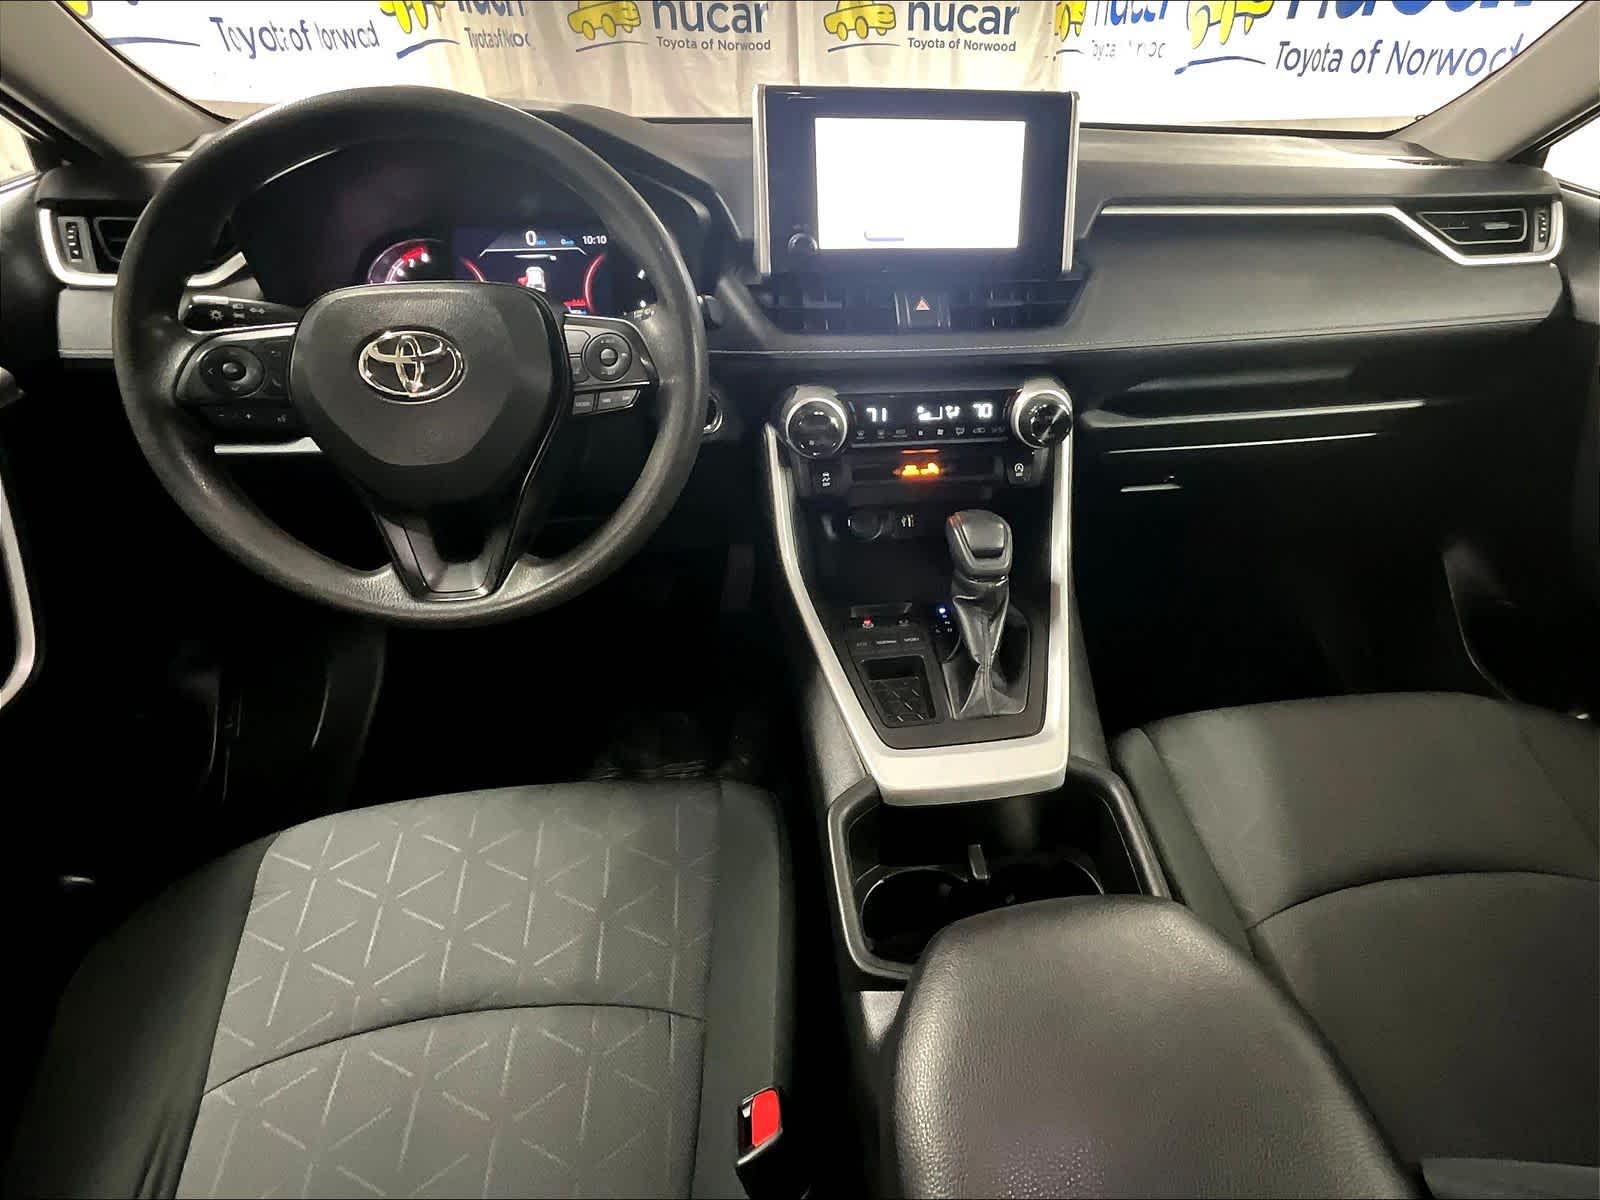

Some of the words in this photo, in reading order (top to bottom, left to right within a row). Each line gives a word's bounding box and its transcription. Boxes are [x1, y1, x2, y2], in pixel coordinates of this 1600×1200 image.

[652, 1, 768, 33] nucar
[907, 1, 1016, 35] nucar
[656, 36, 697, 50] Toyota
[700, 38, 715, 51] of
[717, 39, 771, 51] Norwood
[908, 37, 945, 51] Toyota
[948, 38, 961, 50] of
[963, 39, 1017, 52] Norwood
[1276, 41, 1344, 77] Toyota
[1350, 39, 1383, 74] of
[525, 230, 538, 246] 0
[582, 235, 607, 245] 10:10
[866, 407, 887, 422] 71
[973, 403, 992, 418] 70
